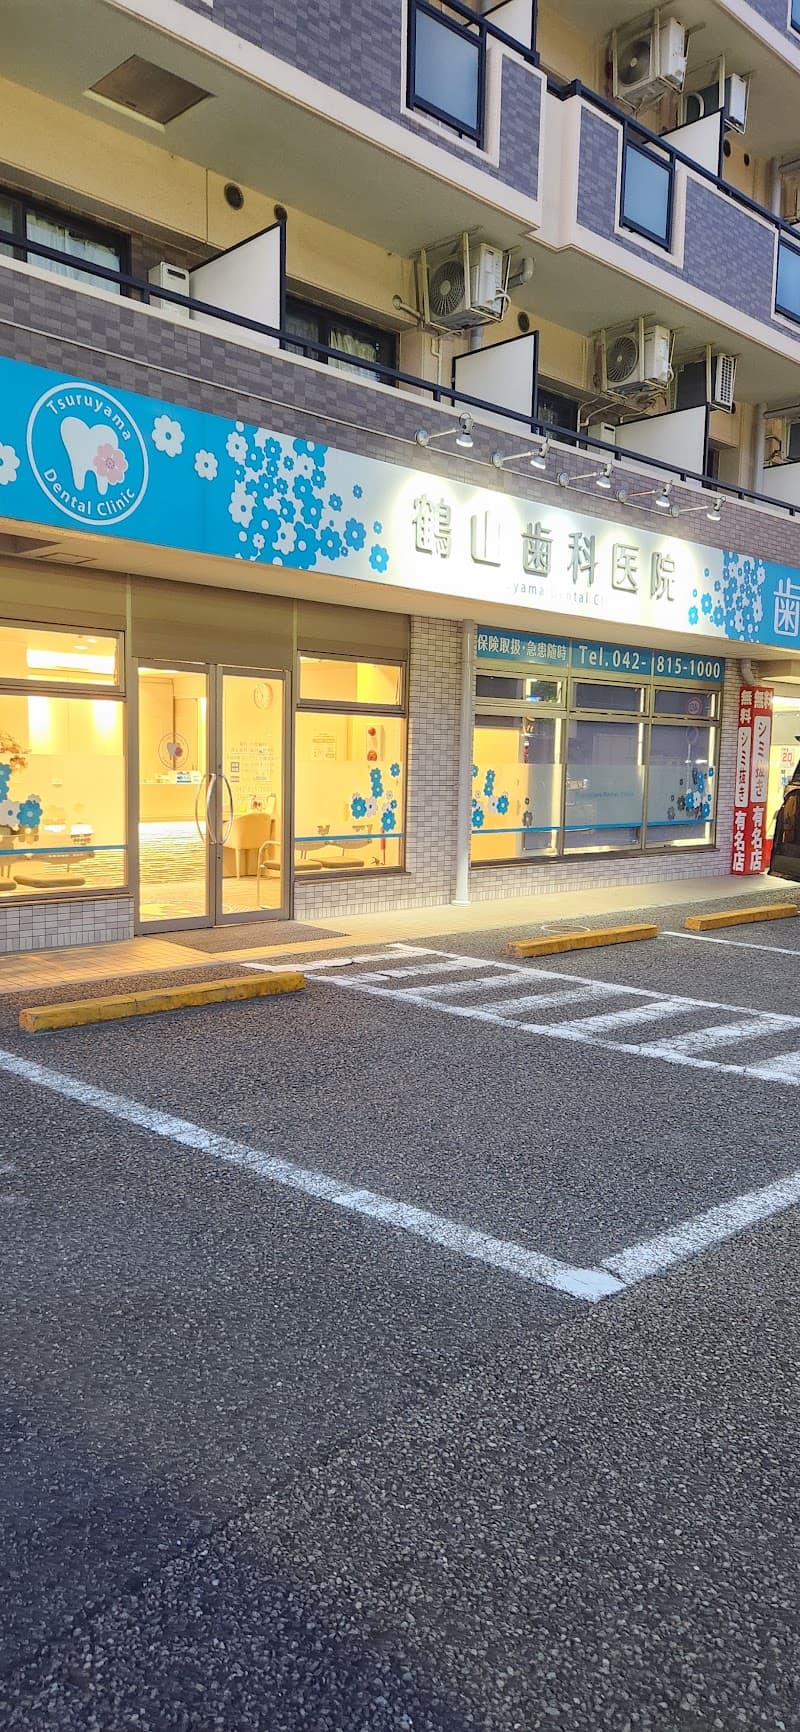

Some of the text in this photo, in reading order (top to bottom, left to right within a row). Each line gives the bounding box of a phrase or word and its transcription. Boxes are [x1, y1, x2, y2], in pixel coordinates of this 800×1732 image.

[46, 394, 131, 441] Tsuruyama
[44, 468, 135, 516] Dental Clinic
[411, 494, 676, 602] 鶴山歯科医院
[773, 577, 800, 637] 歯
[656, 655, 720, 679] 815-1000
[733, 811, 747, 872] 有名店
[750, 806, 764, 871] 有名店
